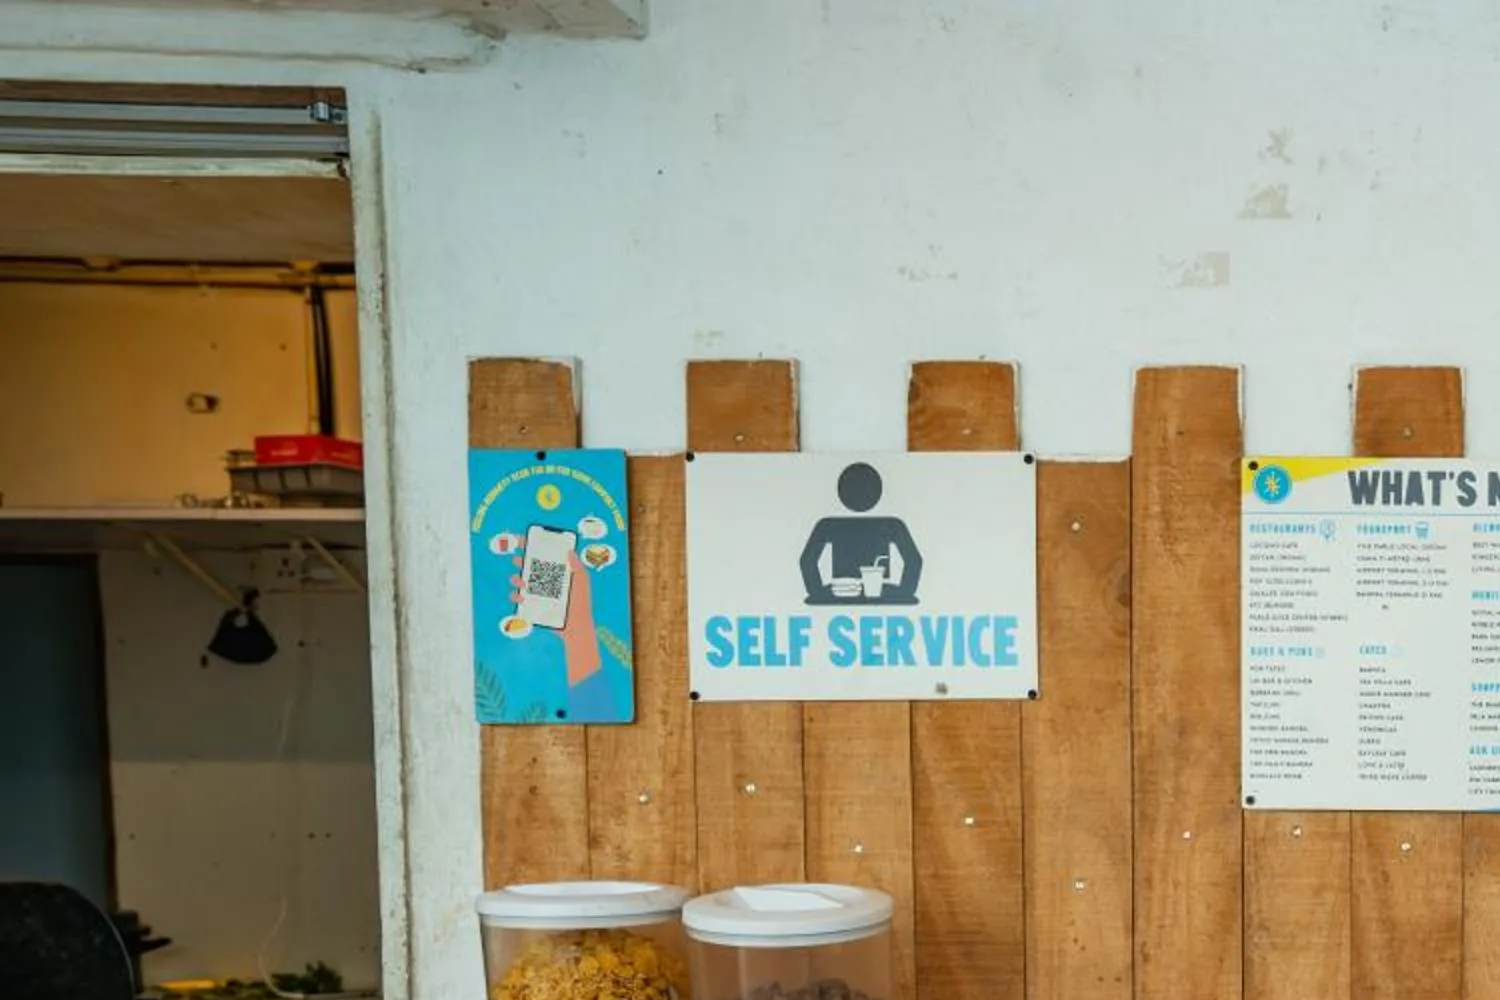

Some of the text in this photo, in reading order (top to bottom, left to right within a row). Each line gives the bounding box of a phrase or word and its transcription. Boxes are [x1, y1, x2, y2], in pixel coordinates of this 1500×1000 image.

[1347, 470, 1478, 507] WHAT'S
[1249, 523, 1316, 534] RESTAURANTS
[1356, 524, 1411, 534] TRANSPORT
[705, 615, 1018, 669] SELF SERVICE
[1470, 746, 1488, 756] ASK
